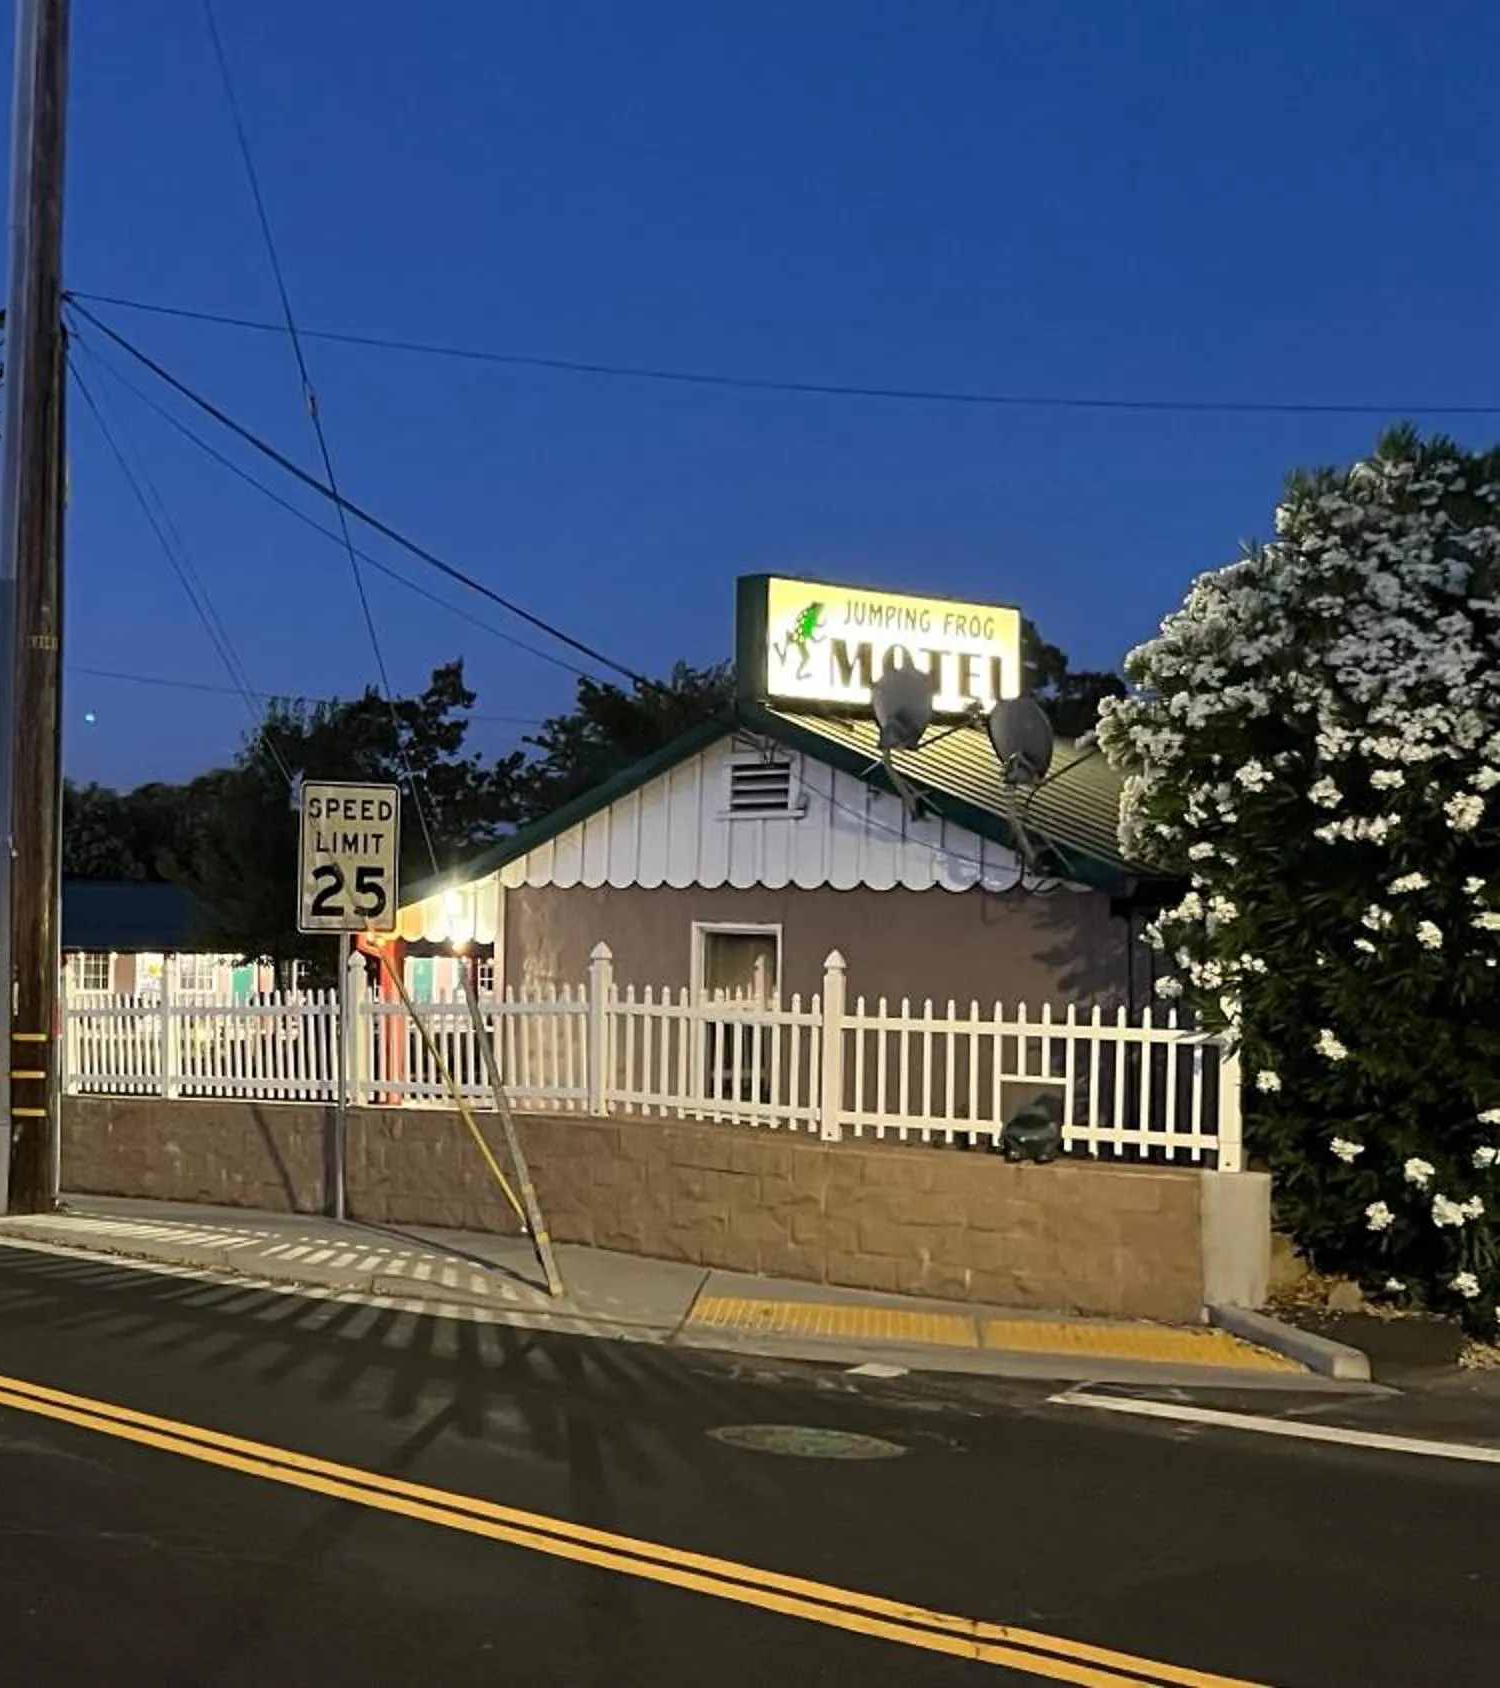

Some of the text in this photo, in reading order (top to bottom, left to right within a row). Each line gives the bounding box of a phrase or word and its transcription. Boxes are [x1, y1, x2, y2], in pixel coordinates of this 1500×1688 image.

[843, 599, 995, 641] JUMPING FROG
[309, 798, 393, 821] SPEED
[316, 831, 384, 854] LIMIT
[312, 863, 387, 918] 25
